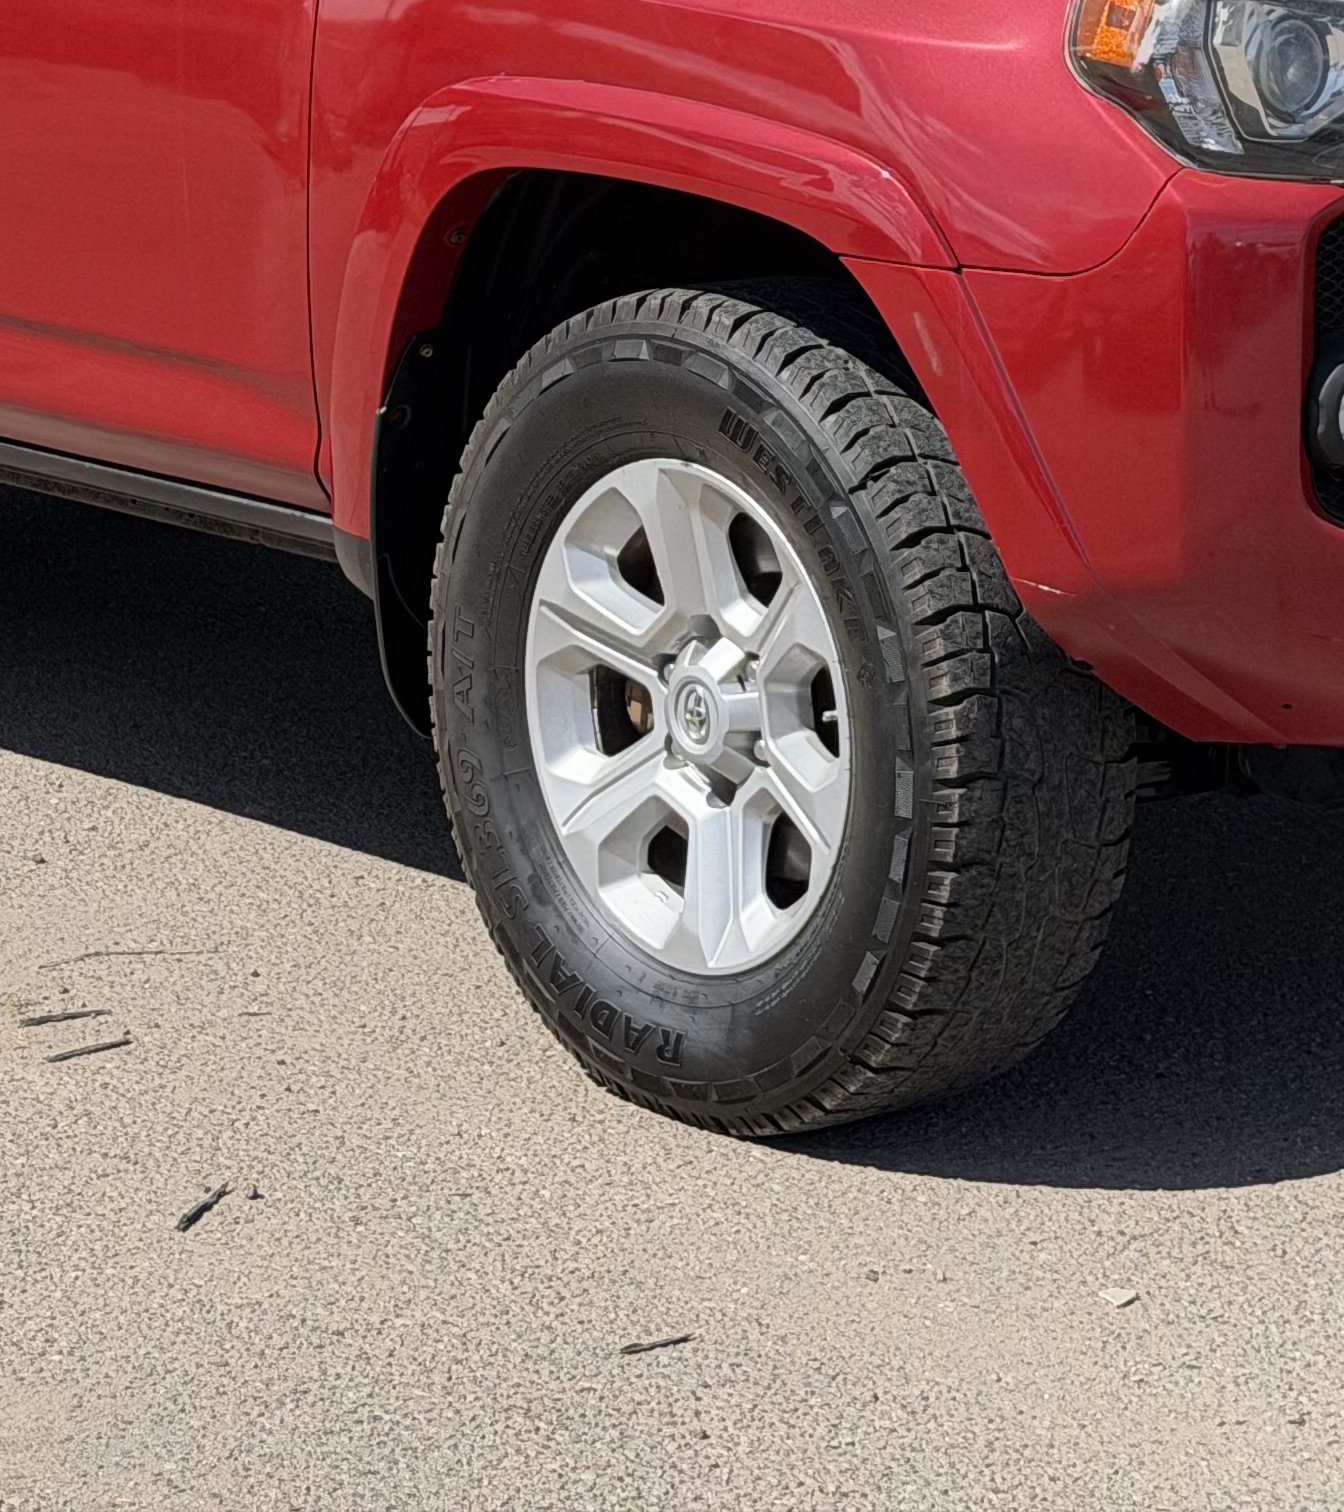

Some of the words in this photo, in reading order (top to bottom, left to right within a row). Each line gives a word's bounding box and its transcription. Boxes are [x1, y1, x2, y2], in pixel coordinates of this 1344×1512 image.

[452, 604, 475, 725] A/T
[456, 747, 531, 921] SL369
[531, 922, 689, 1068] RADIAL
